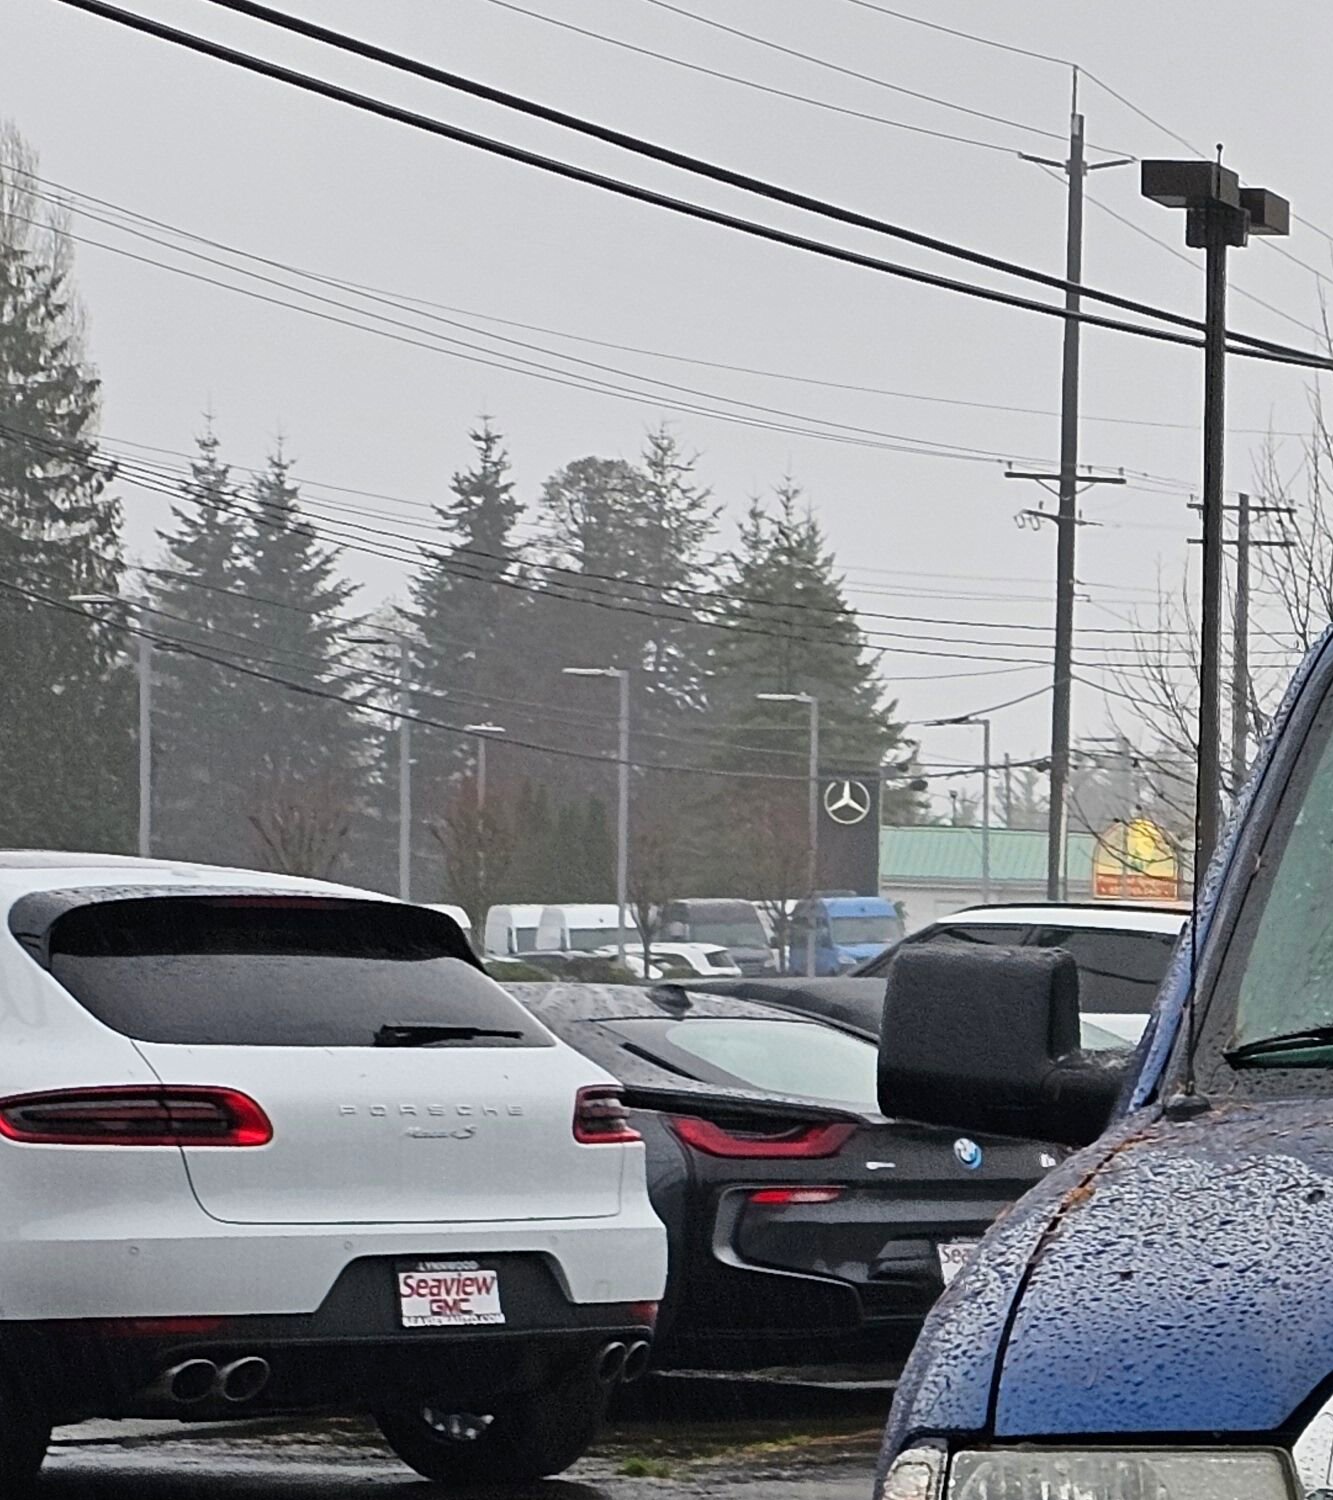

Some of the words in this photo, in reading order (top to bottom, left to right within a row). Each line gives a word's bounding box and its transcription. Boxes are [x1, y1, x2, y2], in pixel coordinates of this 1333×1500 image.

[340, 1104, 524, 1117] PORSCHE
[400, 1273, 496, 1298] Seaview
[430, 1298, 473, 1316] GMC
